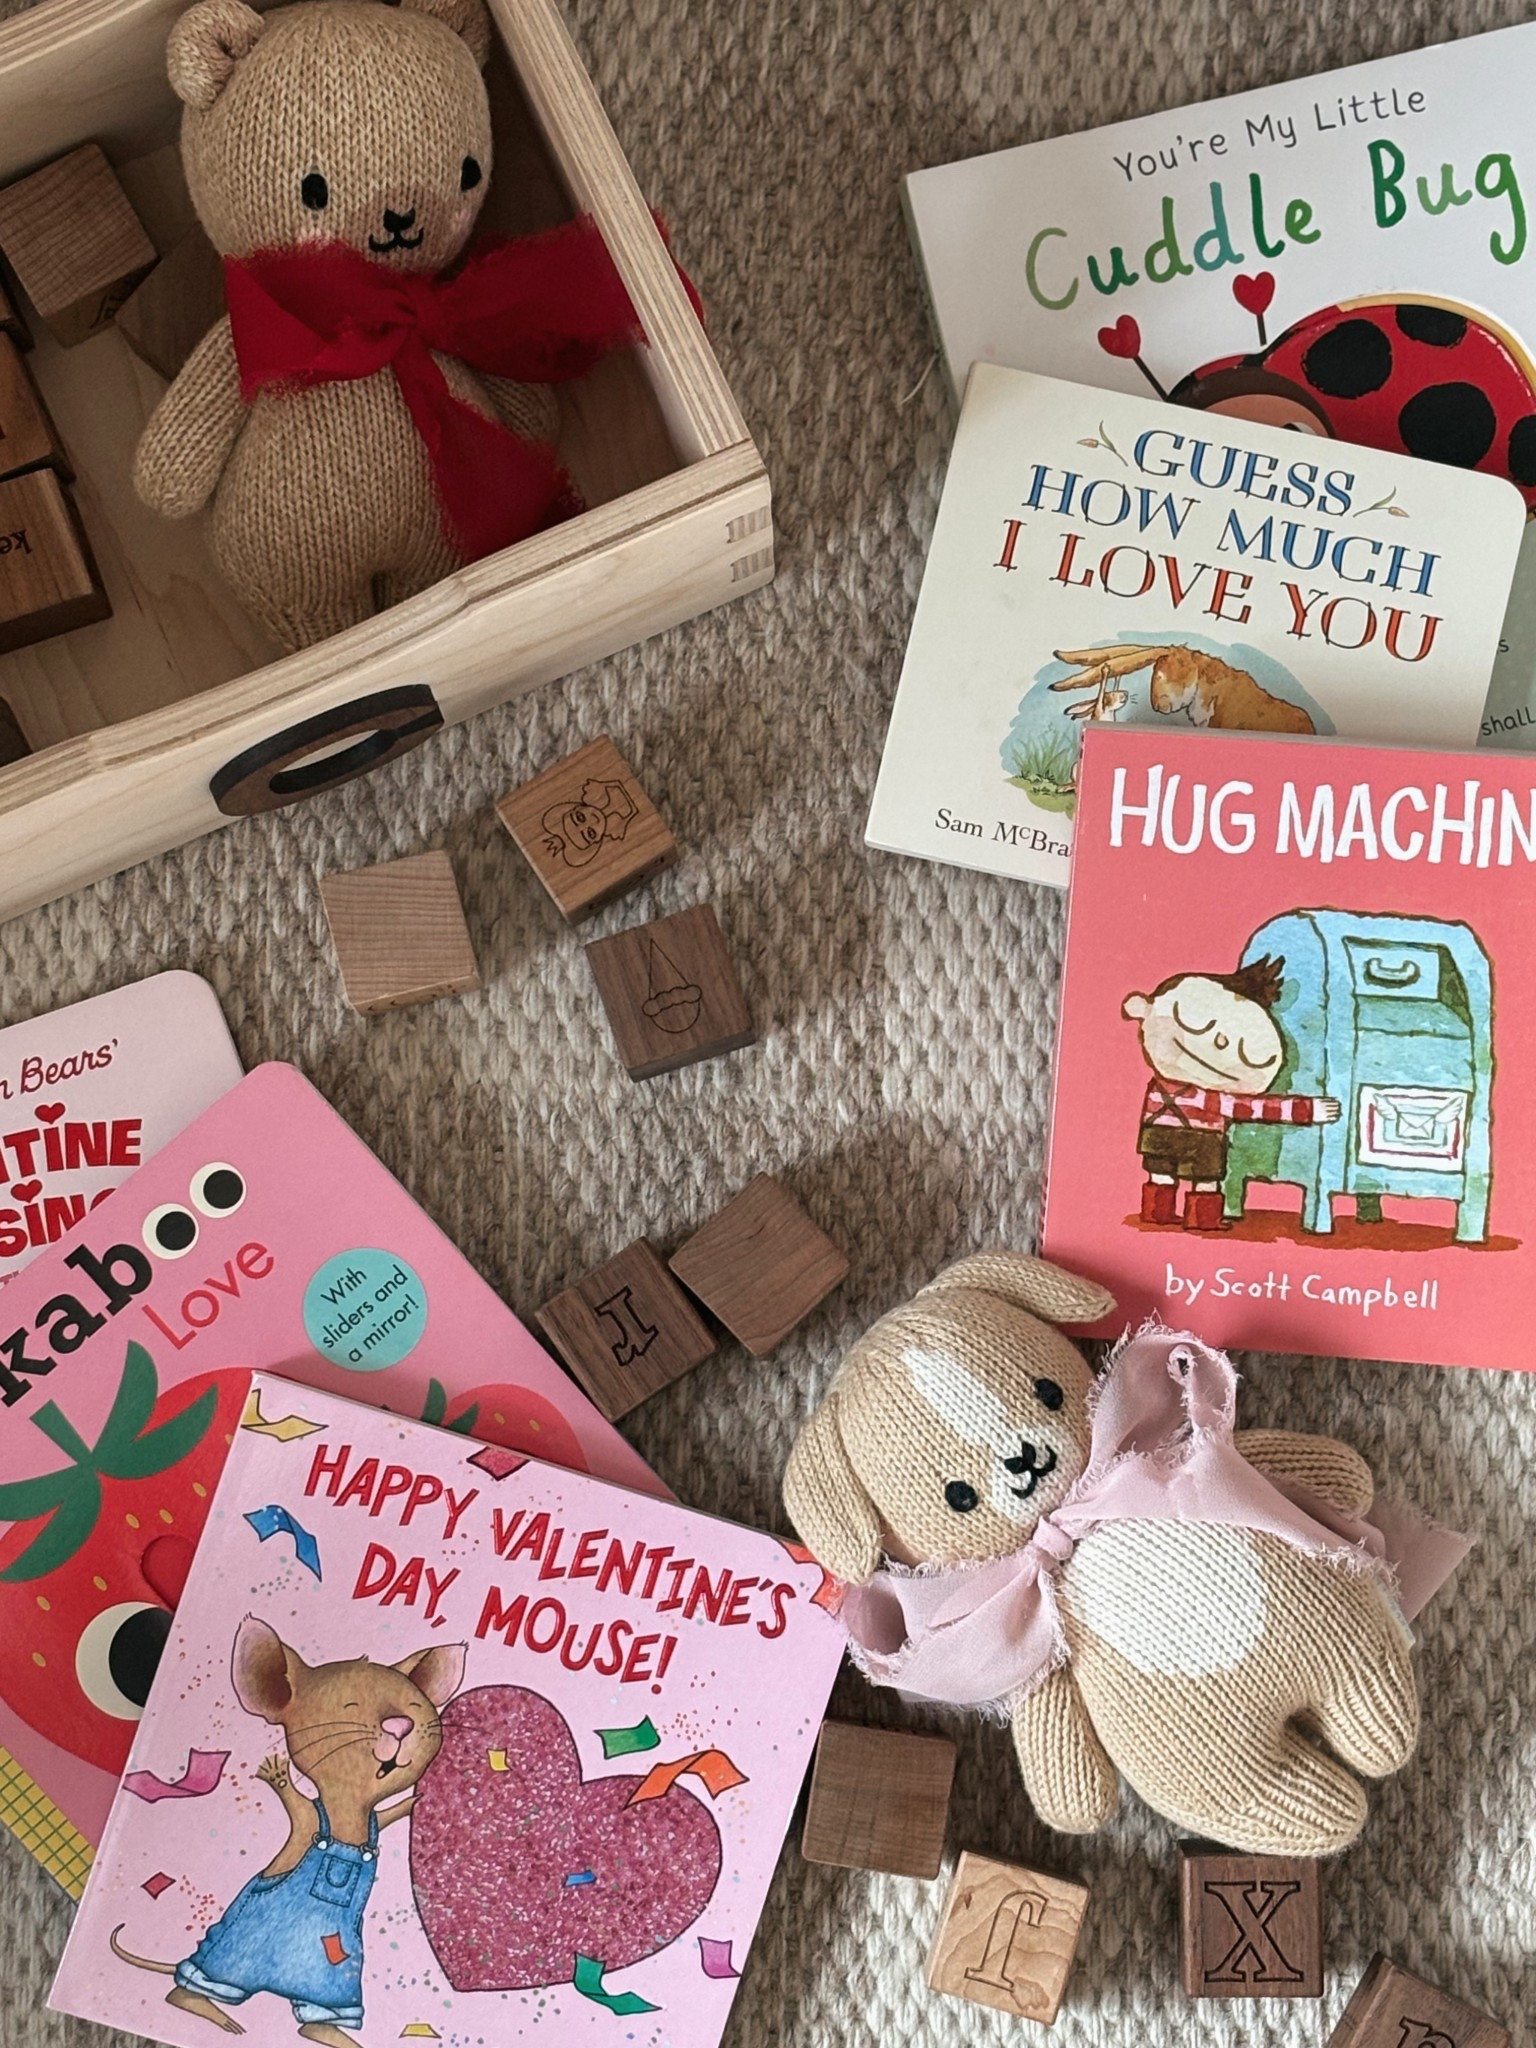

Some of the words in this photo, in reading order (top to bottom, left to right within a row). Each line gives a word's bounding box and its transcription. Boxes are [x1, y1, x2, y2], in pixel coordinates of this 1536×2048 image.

[1113, 131, 1229, 183] You're
[1245, 114, 1298, 148] My
[1314, 87, 1428, 132] Little
[1025, 172, 1322, 311] Cuddle
[1367, 138, 1528, 265] Bug
[1133, 429, 1357, 518] GUESS
[1020, 464, 1202, 541] HOW
[1216, 508, 1443, 598] MUCH
[992, 518, 1029, 574] I
[1048, 532, 1254, 625] LOVE
[1280, 580, 1445, 664] YOU
[935, 808, 984, 838] Sam
[991, 821, 1073, 858] McBra
[1108, 763, 1256, 856] HUG
[1275, 779, 1536, 869] MACHIN
[20, 1038, 119, 1094] Bears'
[0, 1102, 143, 1184] TINE
[0, 1179, 117, 1258] SIN
[141, 1241, 275, 1350] Love
[320, 1267, 367, 1305] With
[322, 1300, 374, 1348] sliders
[374, 1263, 408, 1302] and
[348, 1347, 363, 1362] a
[362, 1293, 420, 1350] mirror!
[1164, 1263, 1204, 1304] by
[1209, 1268, 1293, 1301] Scott
[1302, 1274, 1439, 1317] Campbell
[304, 1443, 481, 1540] HAPPY
[489, 1507, 797, 1640] VALENTINE'S
[352, 1541, 461, 1628] DAY,
[473, 1585, 678, 1695] MOUSE!
